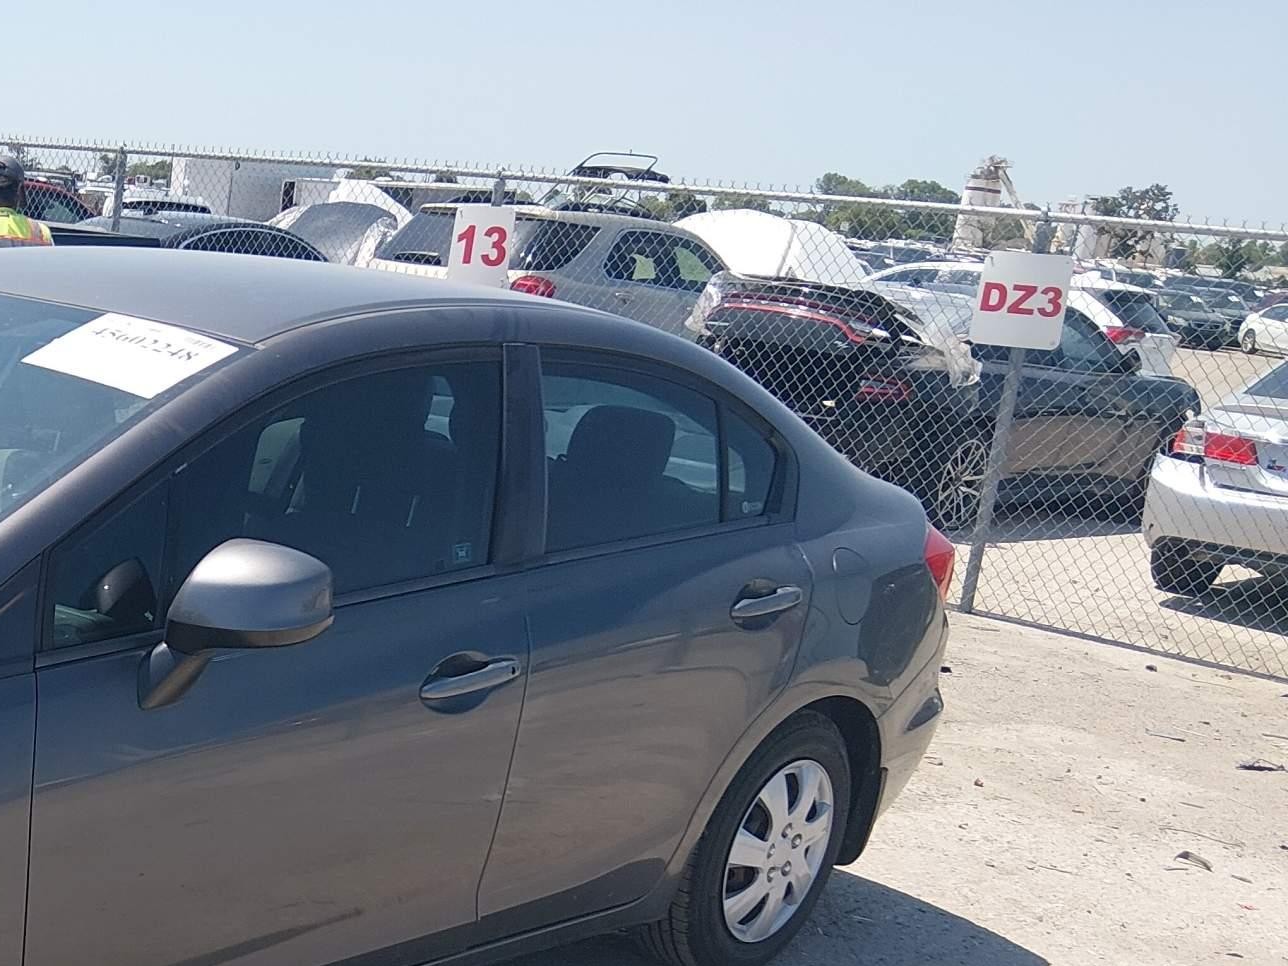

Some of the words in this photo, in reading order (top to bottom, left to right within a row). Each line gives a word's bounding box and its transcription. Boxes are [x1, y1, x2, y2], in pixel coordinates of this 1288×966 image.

[456, 224, 508, 267] 13
[979, 281, 1063, 318] DZ3
[92, 327, 200, 361] 45602248
